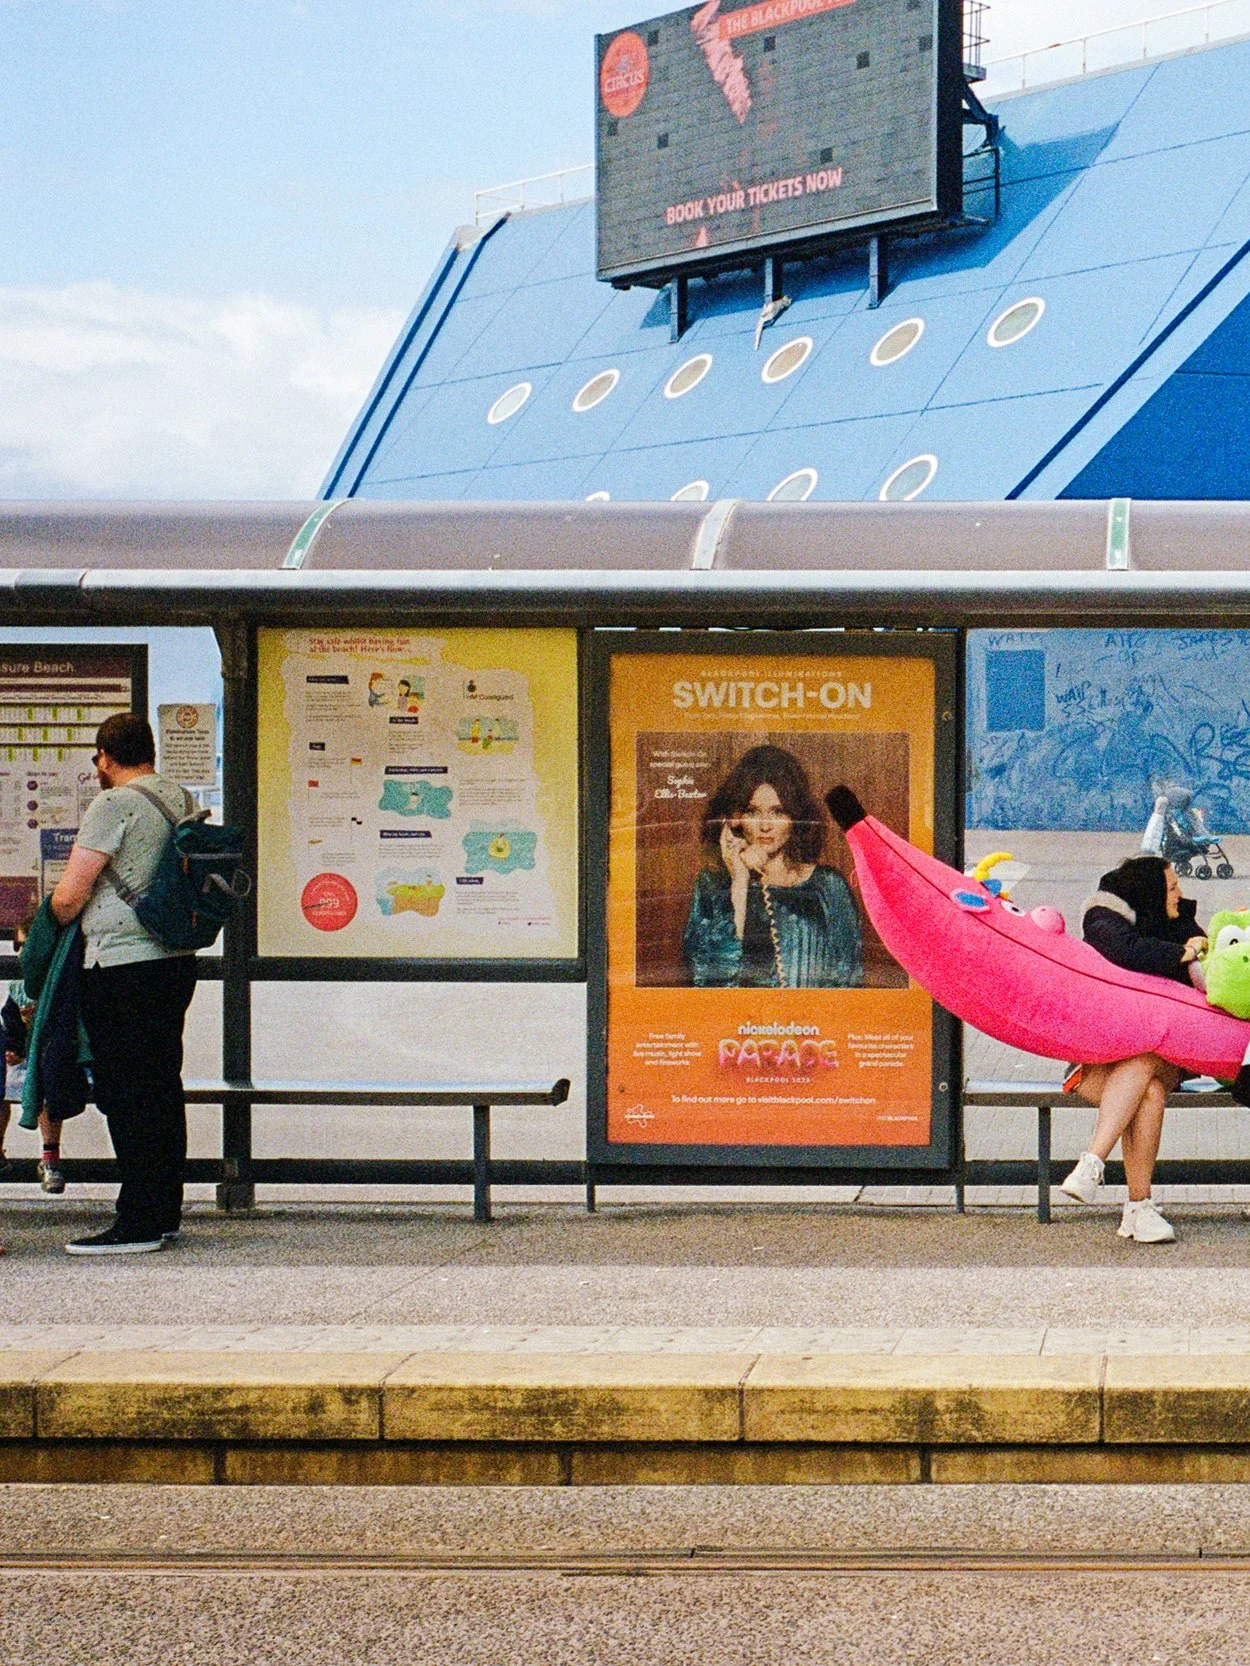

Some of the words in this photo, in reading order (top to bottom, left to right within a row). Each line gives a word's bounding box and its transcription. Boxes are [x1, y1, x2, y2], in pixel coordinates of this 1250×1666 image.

[727, 14, 748, 34] THE
[604, 70, 645, 93] CIRCUS
[666, 201, 704, 225] BOOK
[706, 191, 746, 215] YOUR
[748, 176, 803, 206] TICKETS
[805, 167, 843, 192] NOW
[34, 661, 74, 673] Beach
[672, 680, 872, 710] SWITCH-ON
[738, 1021, 820, 1036] nickelodeon
[718, 1038, 839, 1068] PARADE
[671, 1095, 681, 1103] To
[682, 1095, 697, 1103] find
[736, 1097, 747, 1105] go
[758, 1096, 876, 1105] visitblackpool.com/switchon
